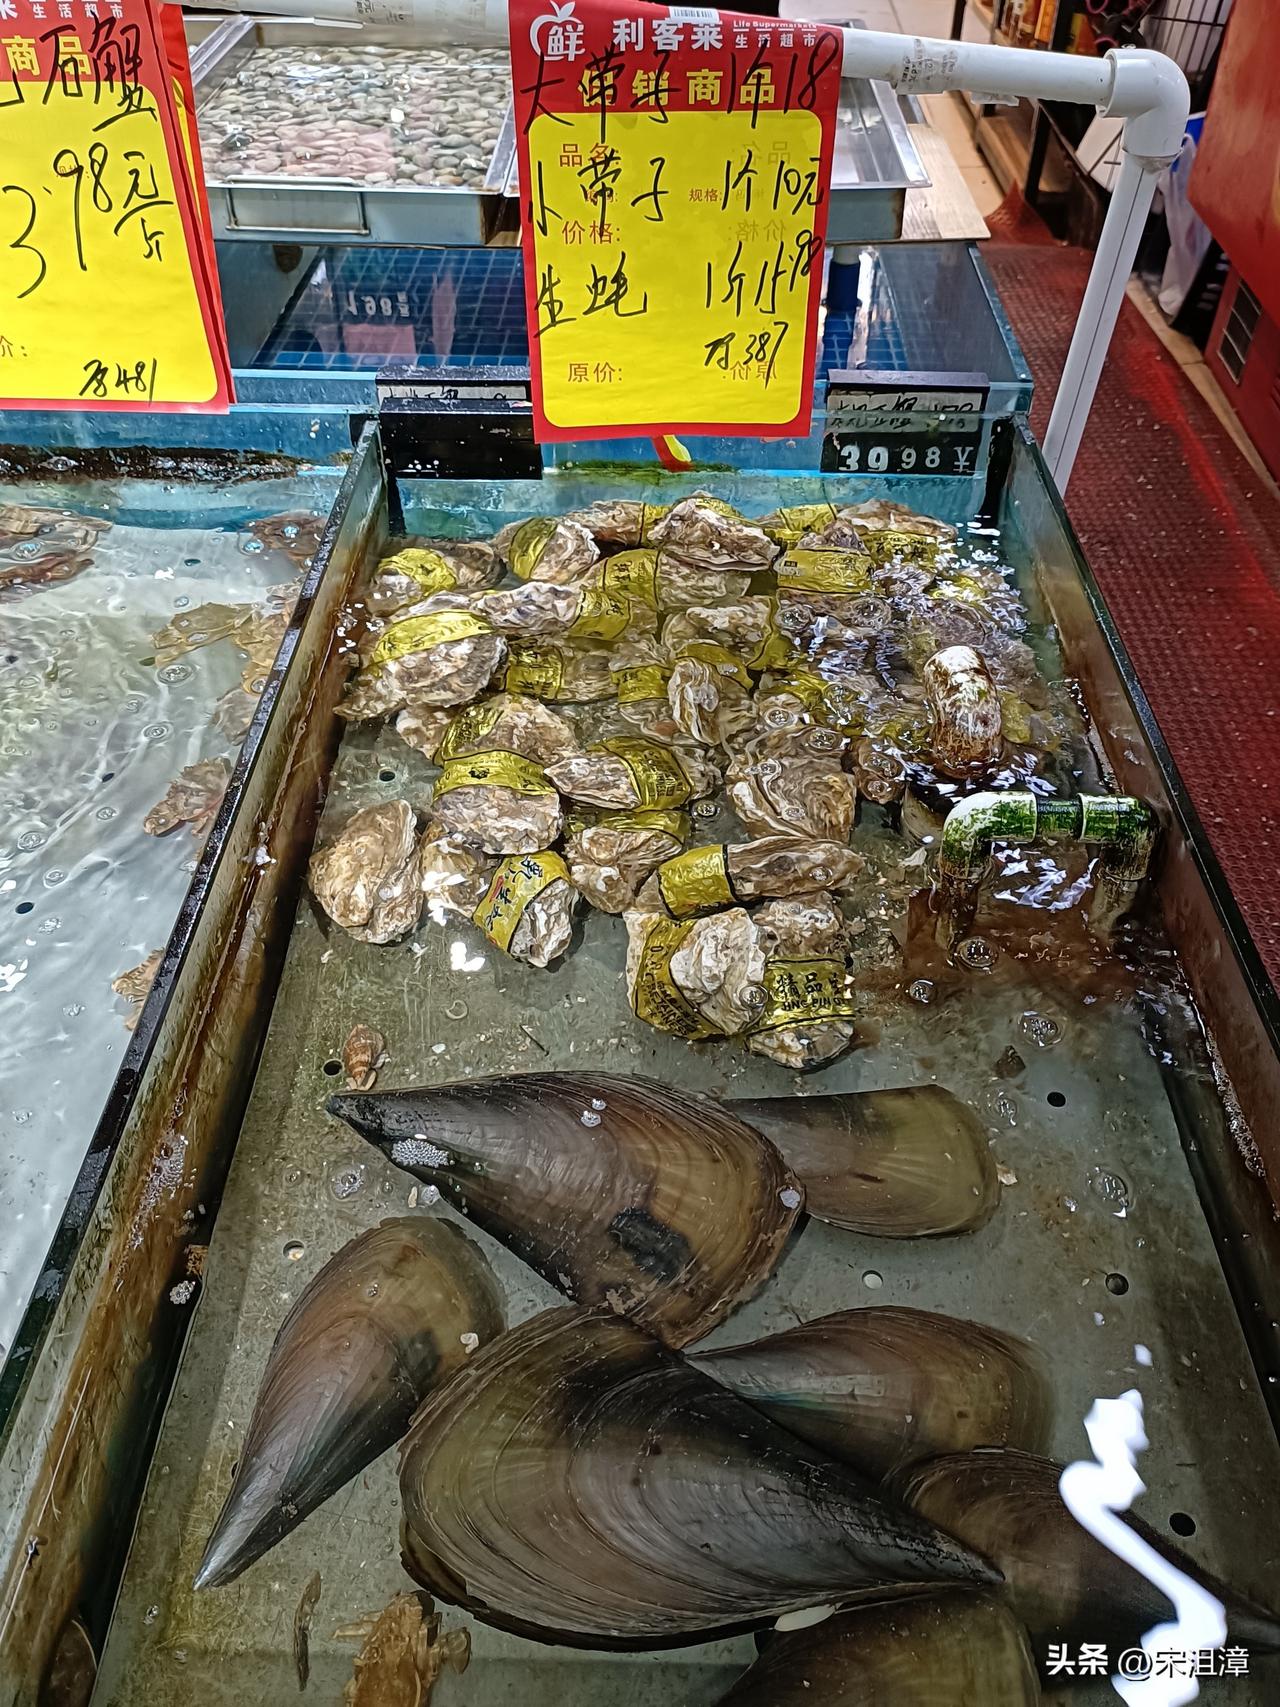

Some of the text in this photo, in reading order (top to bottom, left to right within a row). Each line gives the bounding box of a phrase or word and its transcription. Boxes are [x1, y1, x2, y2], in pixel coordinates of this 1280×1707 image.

[733, 20, 751, 28] Life
[612, 18, 724, 52] 利客莱
[735, 33, 817, 48] 生活超市
[567, 361, 623, 384] 原价:
